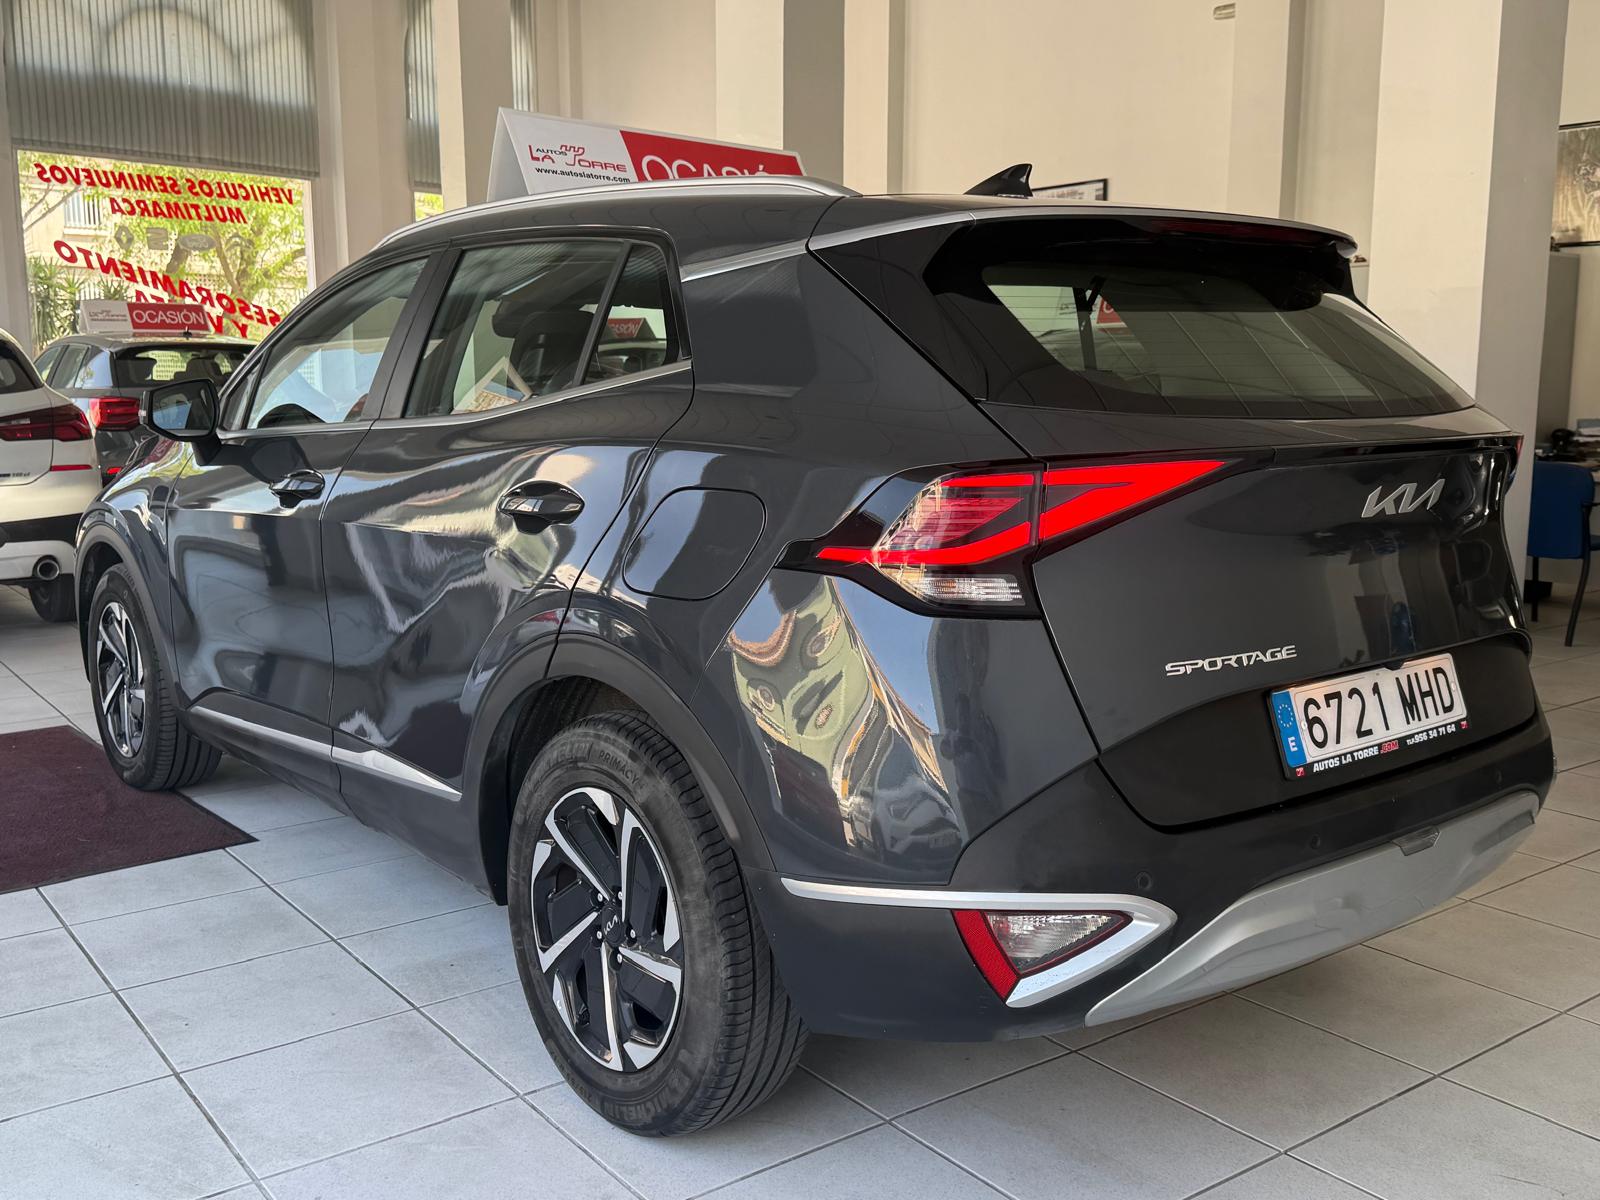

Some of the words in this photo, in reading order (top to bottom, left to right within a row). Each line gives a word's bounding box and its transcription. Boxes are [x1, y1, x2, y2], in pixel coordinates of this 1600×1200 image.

[528, 144, 556, 164] LA
[536, 147, 568, 156] AUTOS
[535, 167, 631, 183] www.autoslatorre.com
[132, 308, 205, 325] OCASIÓN
[1165, 645, 1298, 676] SPORTAGE
[1303, 681, 1391, 749] 6721
[1395, 666, 1455, 725] MHD
[1287, 737, 1298, 752] E
[1313, 755, 1340, 773] AUTOS
[1341, 753, 1353, 764] LA
[1353, 746, 1379, 761] TORRE
